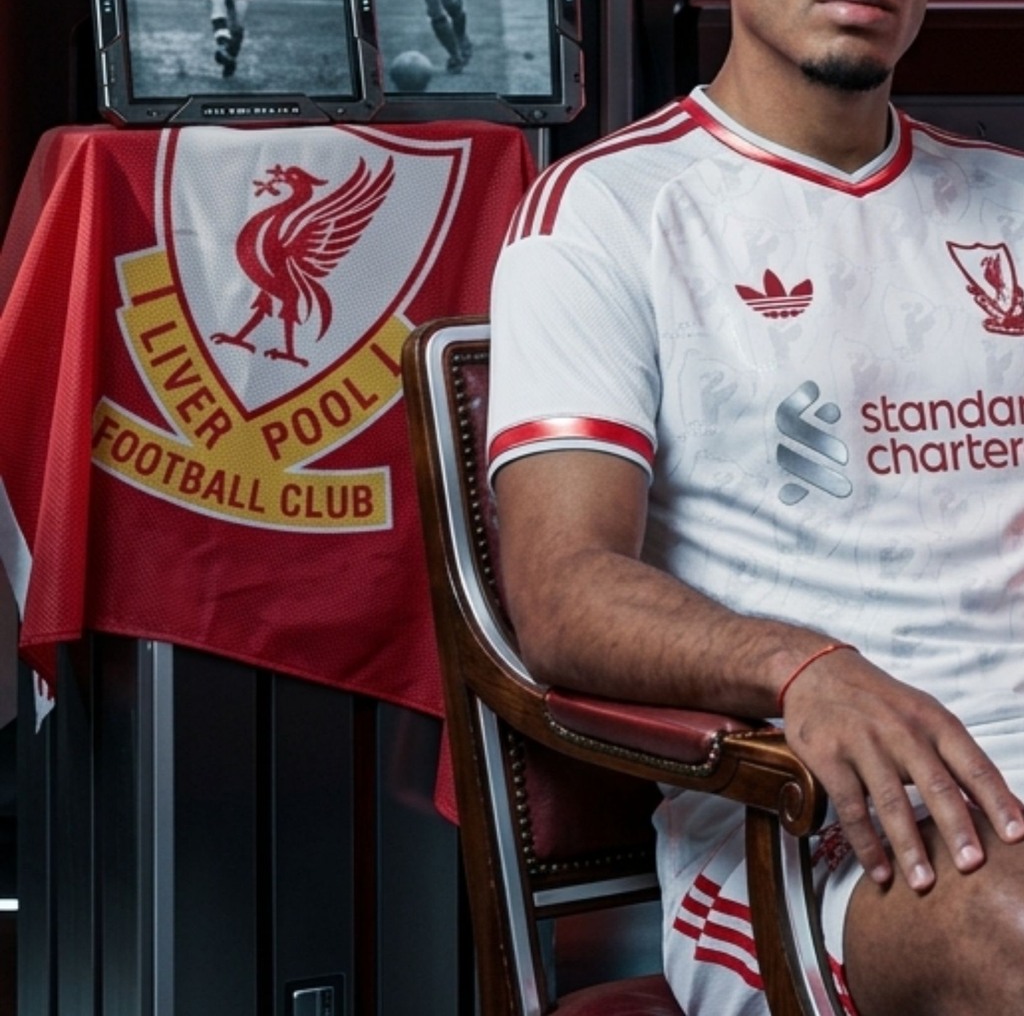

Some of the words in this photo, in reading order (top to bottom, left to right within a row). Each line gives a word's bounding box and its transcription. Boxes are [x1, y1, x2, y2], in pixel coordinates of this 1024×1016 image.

[140, 320, 233, 451] LIVER
[261, 377, 379, 461] POOL
[92, 415, 266, 514] FOOTBALL
[280, 483, 374, 519] CLUB
